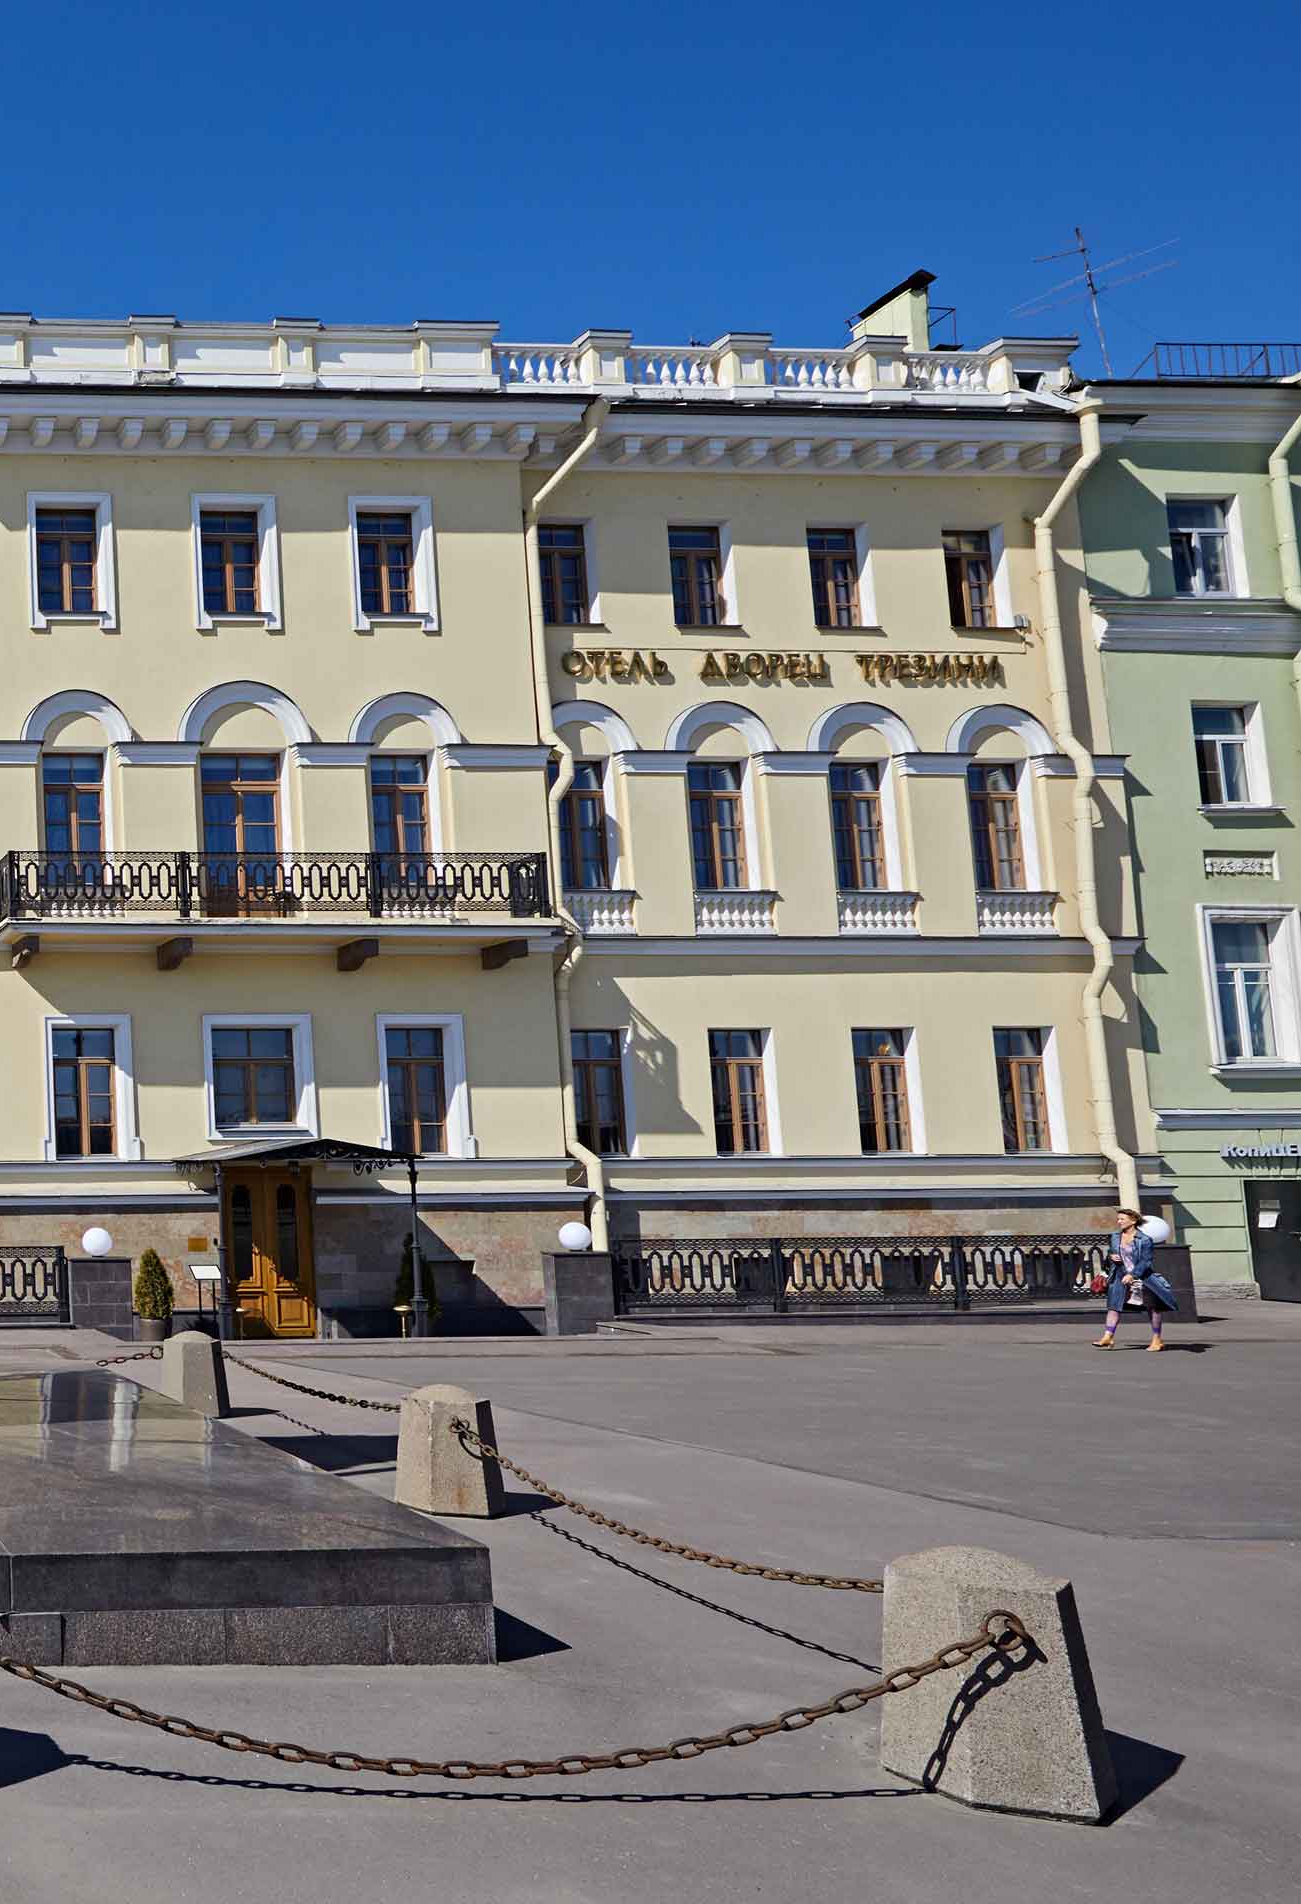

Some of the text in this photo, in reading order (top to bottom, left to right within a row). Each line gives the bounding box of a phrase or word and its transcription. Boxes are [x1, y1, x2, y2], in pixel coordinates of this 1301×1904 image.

[561, 651, 1001, 681] ОТЕЛЬ ДВОРЕЦ ТРЕЗИНИ
